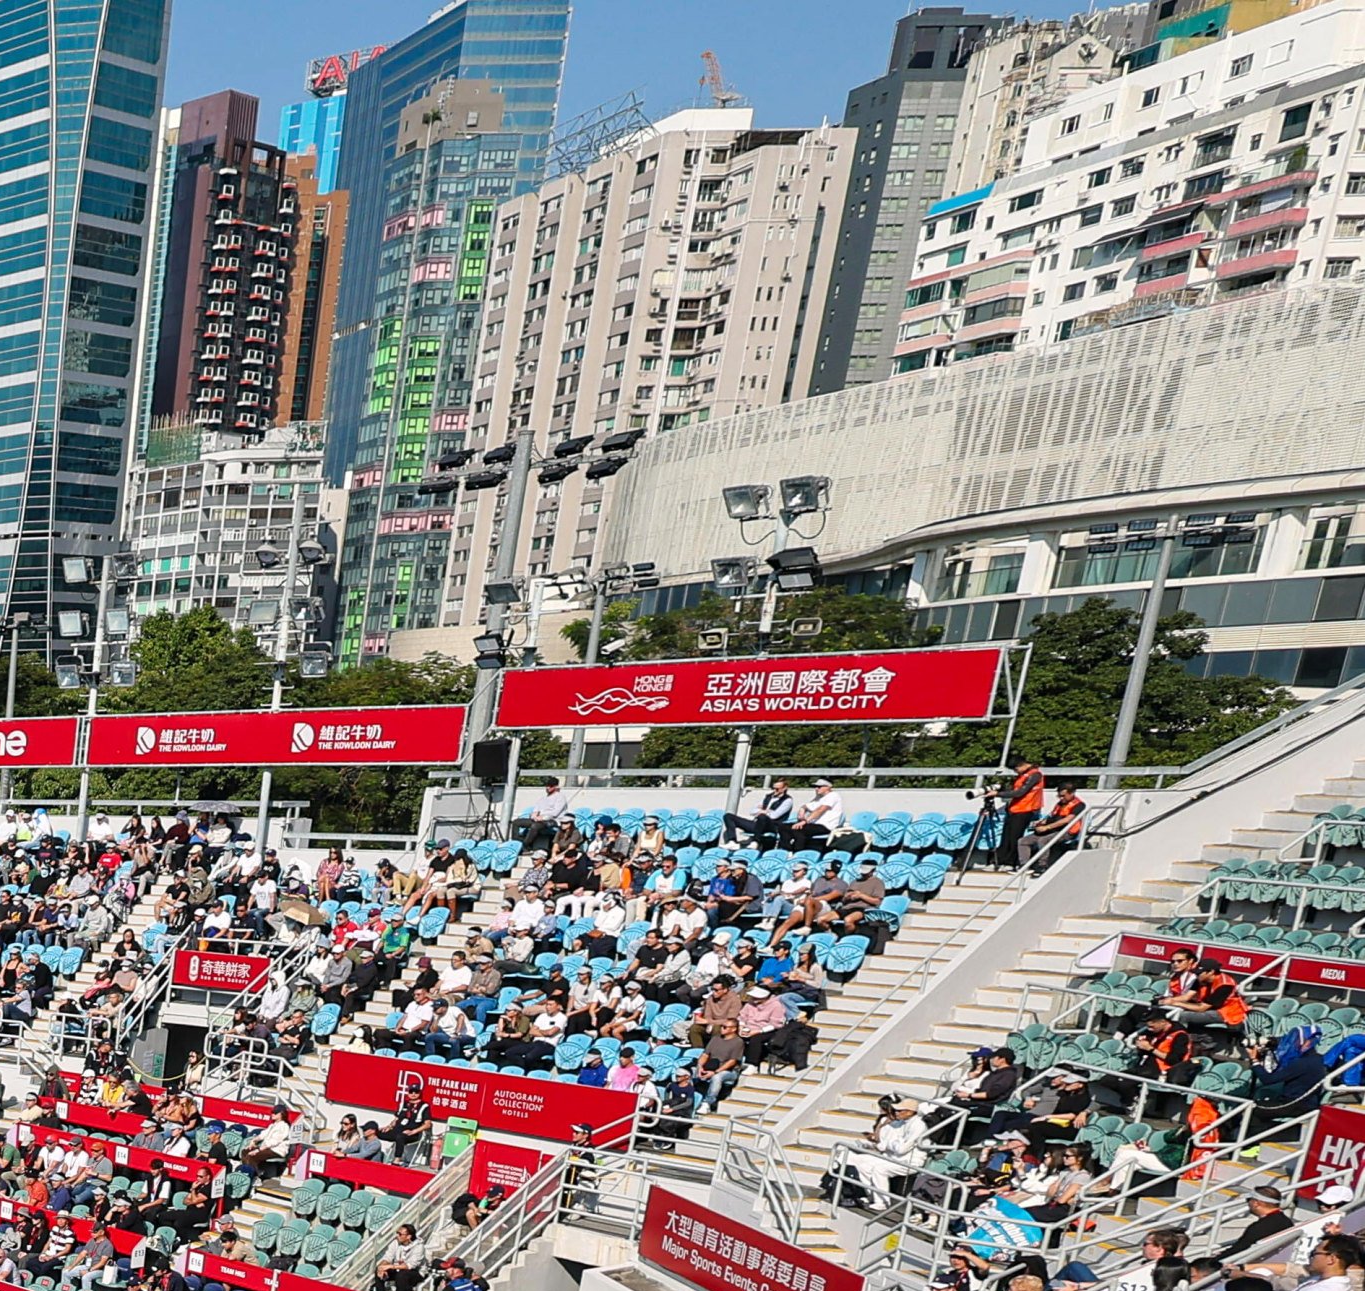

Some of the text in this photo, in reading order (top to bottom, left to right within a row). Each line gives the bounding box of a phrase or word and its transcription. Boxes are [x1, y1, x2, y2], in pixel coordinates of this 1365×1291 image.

[703, 666, 895, 697] 亞洲國際都會
[699, 694, 888, 712] ASIA'S WORLD CITY
[159, 728, 215, 744] 維記牛奶
[318, 724, 382, 741] 維記牛奶
[159, 743, 226, 752] THE KOWLOON DAIRY
[318, 740, 396, 750] THE KOWLOON DAIRY
[1145, 943, 1165, 956] MEDIA
[1229, 955, 1251, 968] MEDIA
[201, 960, 251, 979] 奇華餅家
[1320, 967, 1346, 982] MEDIA
[427, 1076, 478, 1093] THE PARK LANE
[493, 1089, 544, 1104] AUTOGRAPH
[492, 1097, 542, 1112] COLLECTION
[502, 1109, 529, 1119] HOTELS
[1318, 1134, 1365, 1170] HK
[662, 1234, 689, 1260] Major
[690, 1248, 722, 1278] Sports
